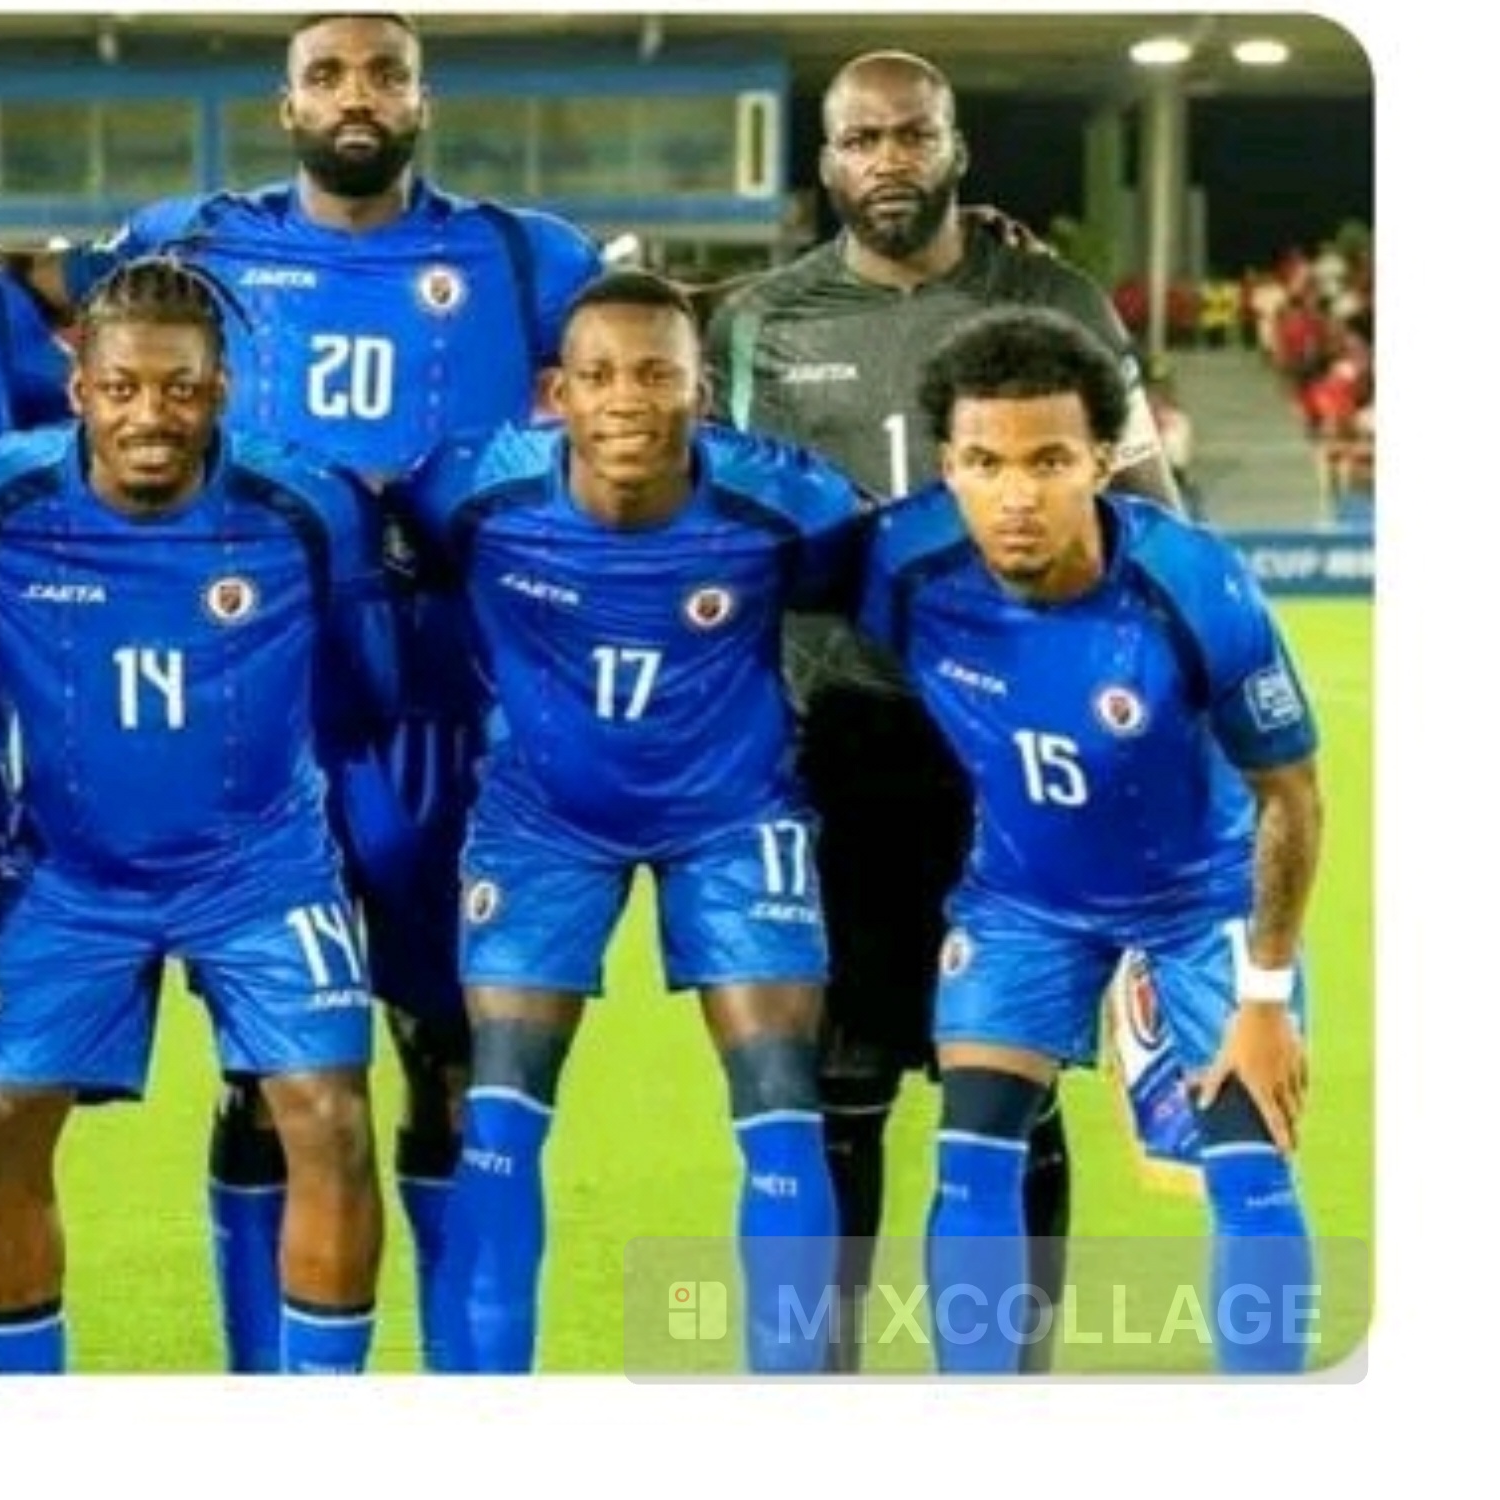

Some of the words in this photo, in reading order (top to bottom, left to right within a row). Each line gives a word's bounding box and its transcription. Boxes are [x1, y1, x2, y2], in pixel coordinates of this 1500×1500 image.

[308, 334, 395, 420] 20
[883, 414, 909, 497] 1
[112, 648, 185, 731] 14
[592, 645, 662, 720] 17
[1014, 730, 1088, 807] 15
[759, 818, 807, 895] 17
